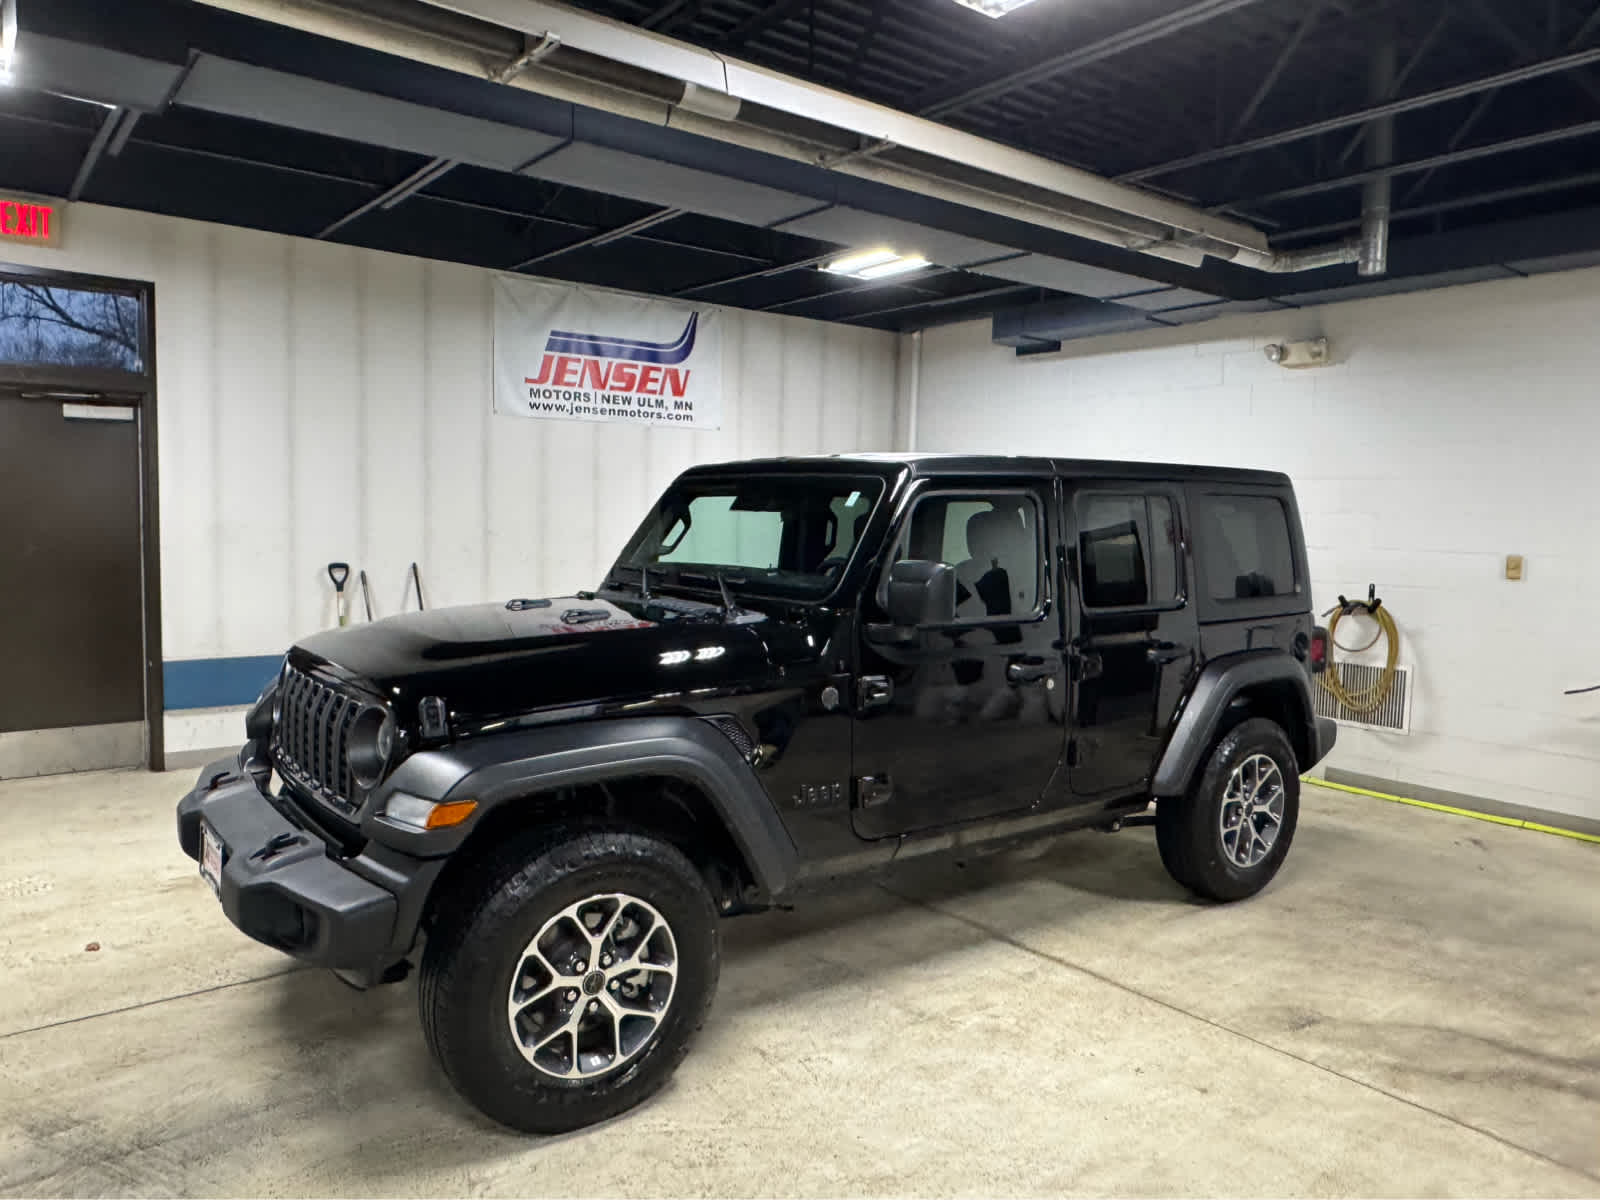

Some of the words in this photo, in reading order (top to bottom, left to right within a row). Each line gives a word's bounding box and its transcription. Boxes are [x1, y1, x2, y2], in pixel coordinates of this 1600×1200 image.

[0, 200, 54, 239] EXIT
[524, 354, 690, 397] JENSEN
[528, 401, 693, 422] www.jensenmotors.com
[529, 388, 591, 403] MOTORS
[601, 394, 632, 406] NEW
[637, 396, 668, 411] ULM,
[673, 400, 693, 411] MN
